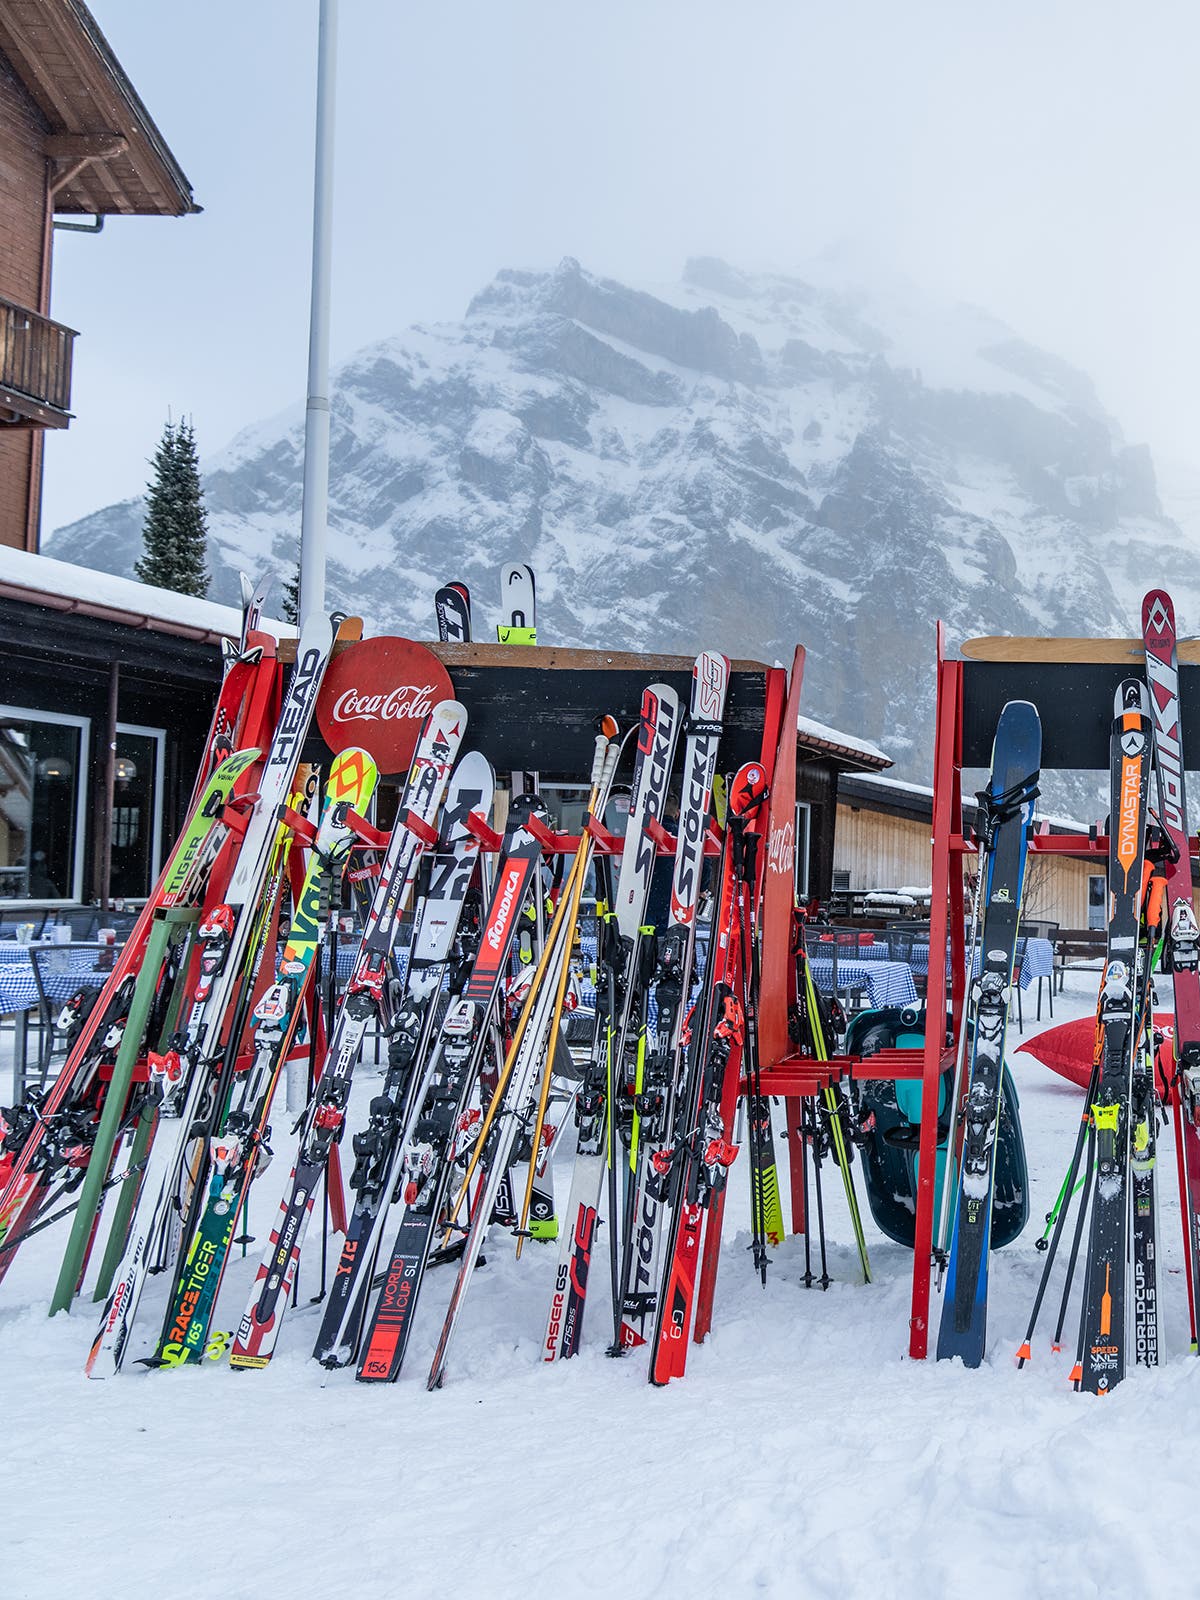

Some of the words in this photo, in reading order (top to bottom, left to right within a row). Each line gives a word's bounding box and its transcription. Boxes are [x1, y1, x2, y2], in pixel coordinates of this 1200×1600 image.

[271, 648, 320, 765] HEAD
[333, 684, 437, 722] Coca-Cola
[679, 718, 710, 908] STÖCKL
[1121, 764, 1139, 855] DYNASTAR
[488, 870, 520, 950] NORDICA
[381, 1259, 404, 1307] WORLD
[404, 1261, 419, 1277] SL
[106, 1282, 126, 1333] HEAD
[397, 1281, 412, 1308] CUP
[544, 1294, 564, 1362] LASER
[556, 1264, 568, 1291] GS
[186, 1323, 203, 1346] 165
[237, 1314, 252, 1341] 181
[1146, 1288, 1158, 1366] REBELS
[367, 1361, 387, 1374] 156
